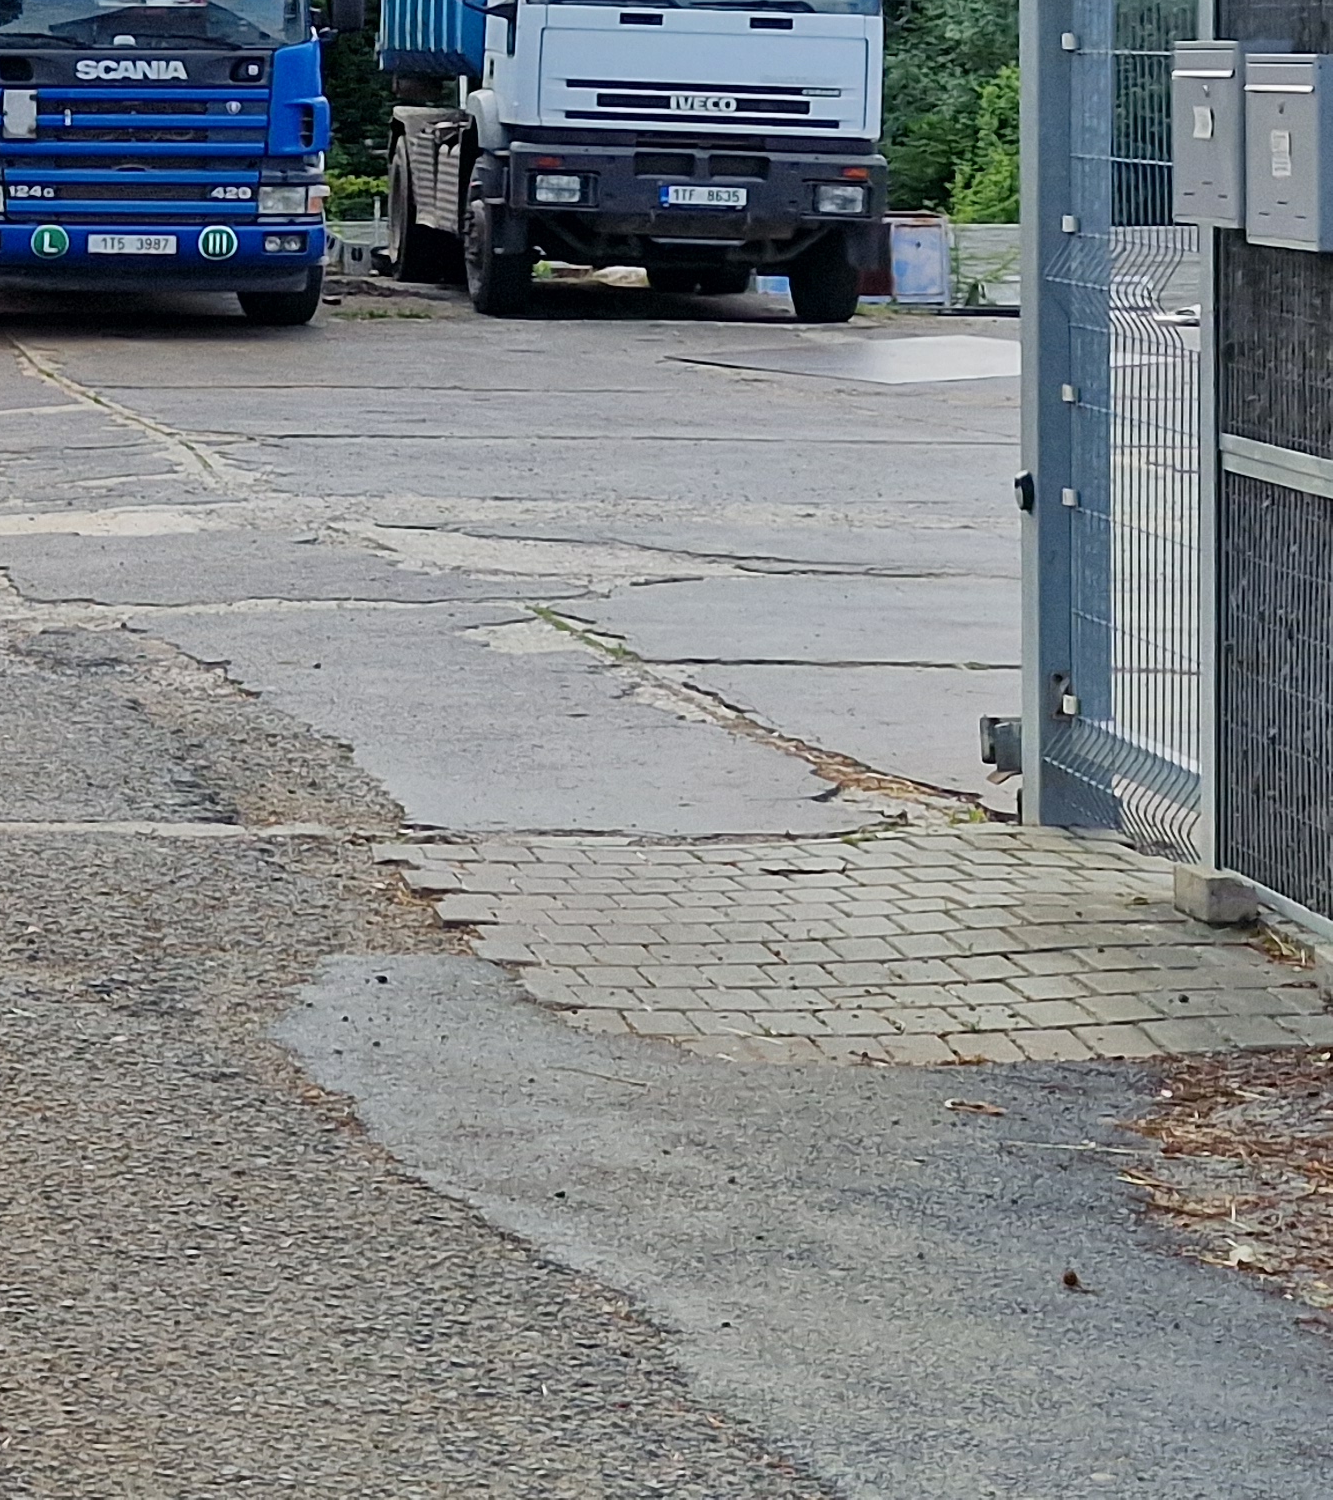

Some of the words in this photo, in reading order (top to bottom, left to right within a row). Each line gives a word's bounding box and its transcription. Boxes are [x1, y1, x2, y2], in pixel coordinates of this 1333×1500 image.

[75, 60, 188, 80] SCANIA
[669, 96, 737, 112] IVECO
[210, 186, 252, 199] 420
[673, 189, 695, 201] 1TF
[707, 190, 739, 203] 8635
[43, 231, 59, 253] L
[101, 238, 125, 250] 1T5
[136, 238, 168, 251] 3987
